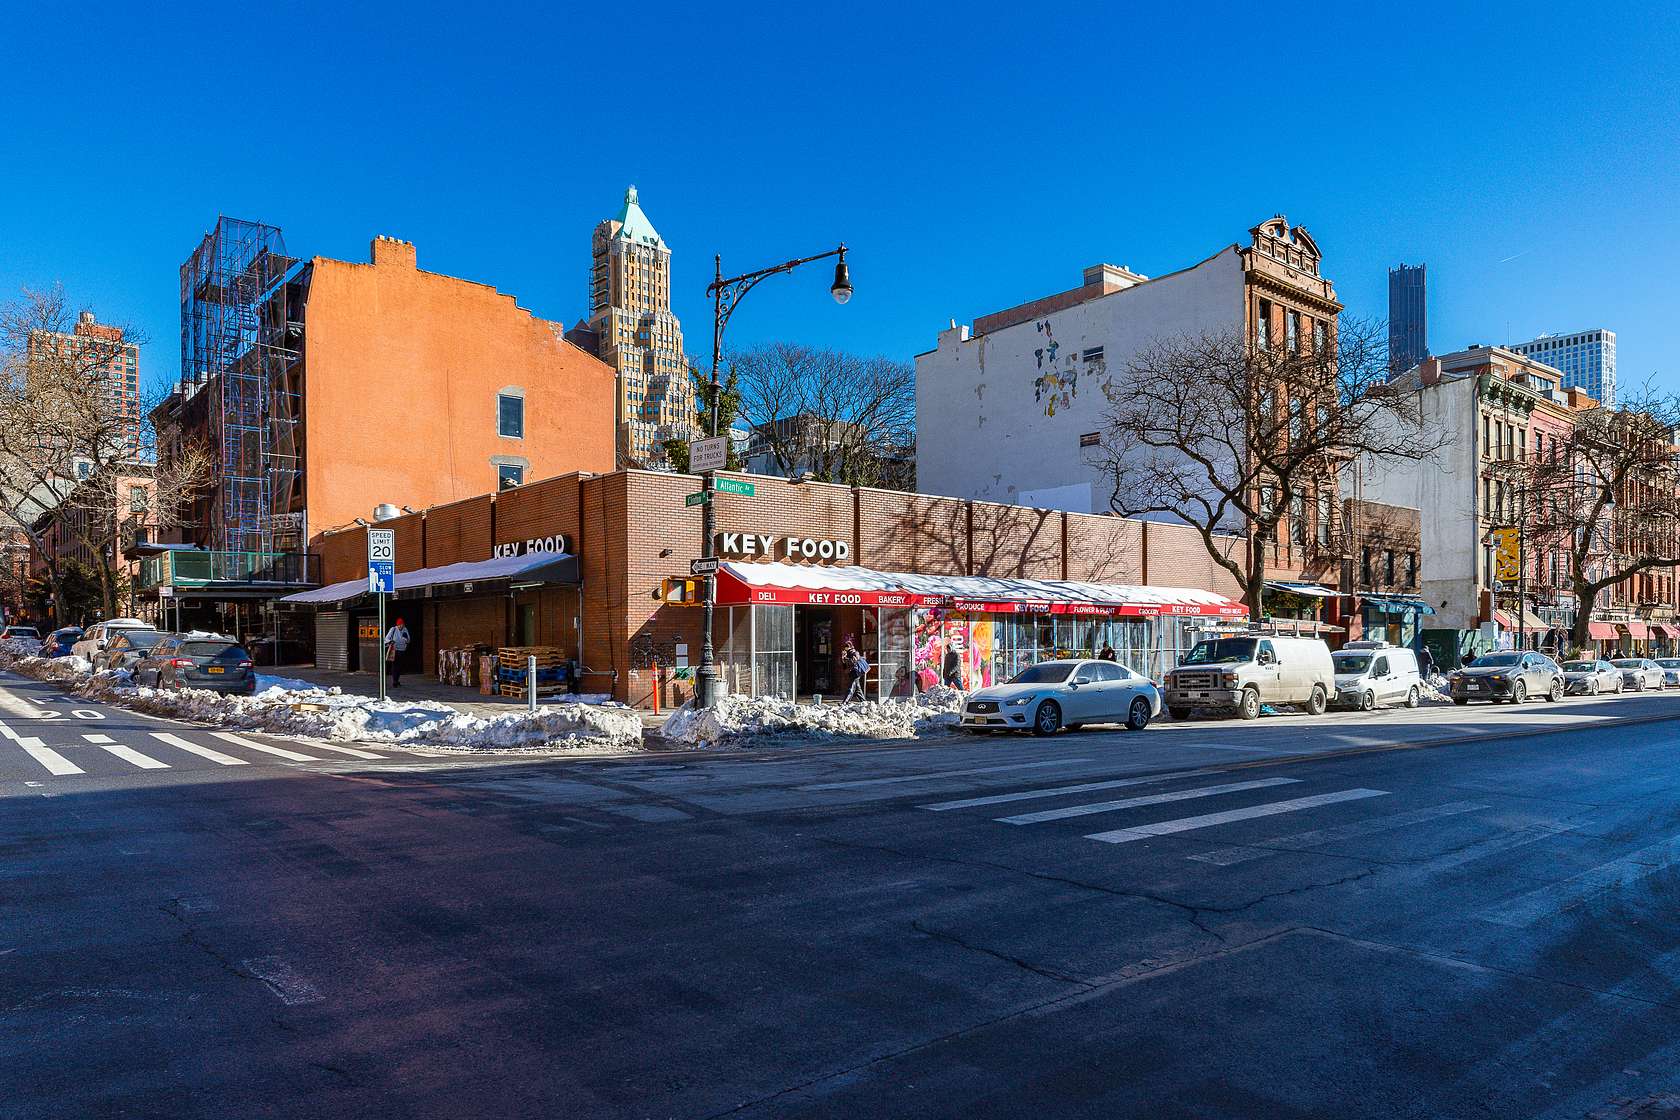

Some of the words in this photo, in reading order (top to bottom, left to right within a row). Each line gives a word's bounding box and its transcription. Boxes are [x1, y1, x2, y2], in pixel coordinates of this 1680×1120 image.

[697, 445, 703, 453] NO
[704, 442, 720, 450] TURNS
[694, 454, 703, 463] FOR
[704, 451, 722, 460] TRUCKS
[720, 481, 744, 493] Atlantic
[494, 542, 520, 560] KEY
[526, 534, 565, 556] FOOD
[723, 532, 774, 555] KEY
[786, 537, 849, 560] FOOD
[373, 546, 391, 558] 20
[758, 591, 776, 601] DELI
[809, 593, 831, 603] KEY
[834, 594, 861, 604] FOOD
[878, 595, 906, 604] BAKERY
[923, 596, 944, 605] FRESH
[955, 602, 985, 611] PRODUCE
[1014, 603, 1029, 612] KEY
[1030, 604, 1050, 613] FOOD
[1073, 606, 1095, 614] FLOWER
[1172, 605, 1184, 613] KEY
[1185, 606, 1201, 614] FOOD
